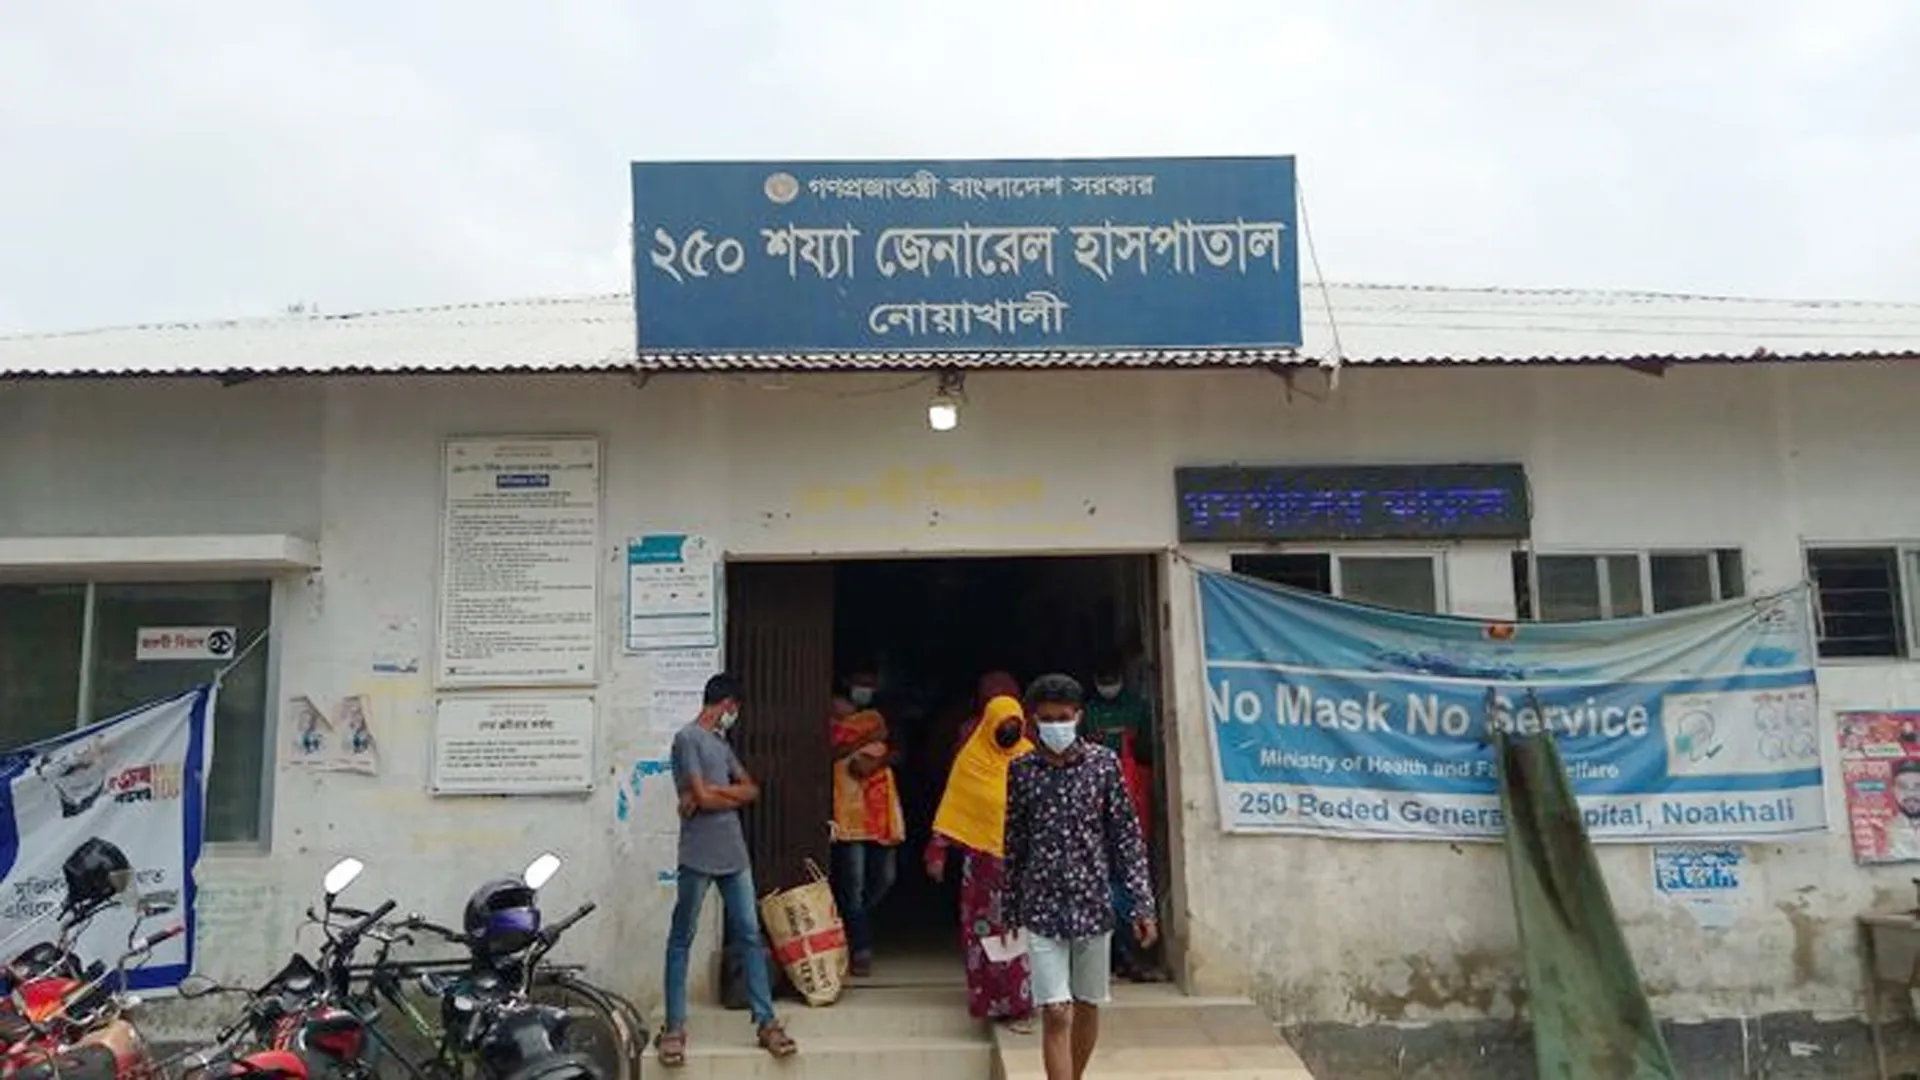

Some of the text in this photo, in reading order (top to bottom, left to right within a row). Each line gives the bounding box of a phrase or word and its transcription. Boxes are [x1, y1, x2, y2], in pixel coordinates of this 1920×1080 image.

[808, 170, 1155, 200] গণপ্রজাতন্ত্রী বাংলাদেশ সরকার
[650, 216, 1286, 284] ২৫০ শয্যা জেনারেল হাসপাতাল
[868, 290, 1070, 336] নোয়াখালী
[1207, 679, 1650, 738] No Mask No Service
[1260, 747, 1336, 772] Ministry
[1341, 754, 1363, 771] of
[1368, 757, 1428, 777] Health
[1433, 760, 1471, 777] and
[1565, 758, 1620, 779] elfare
[1239, 792, 1795, 829] 250 Beded Genera pital, Noakhali
